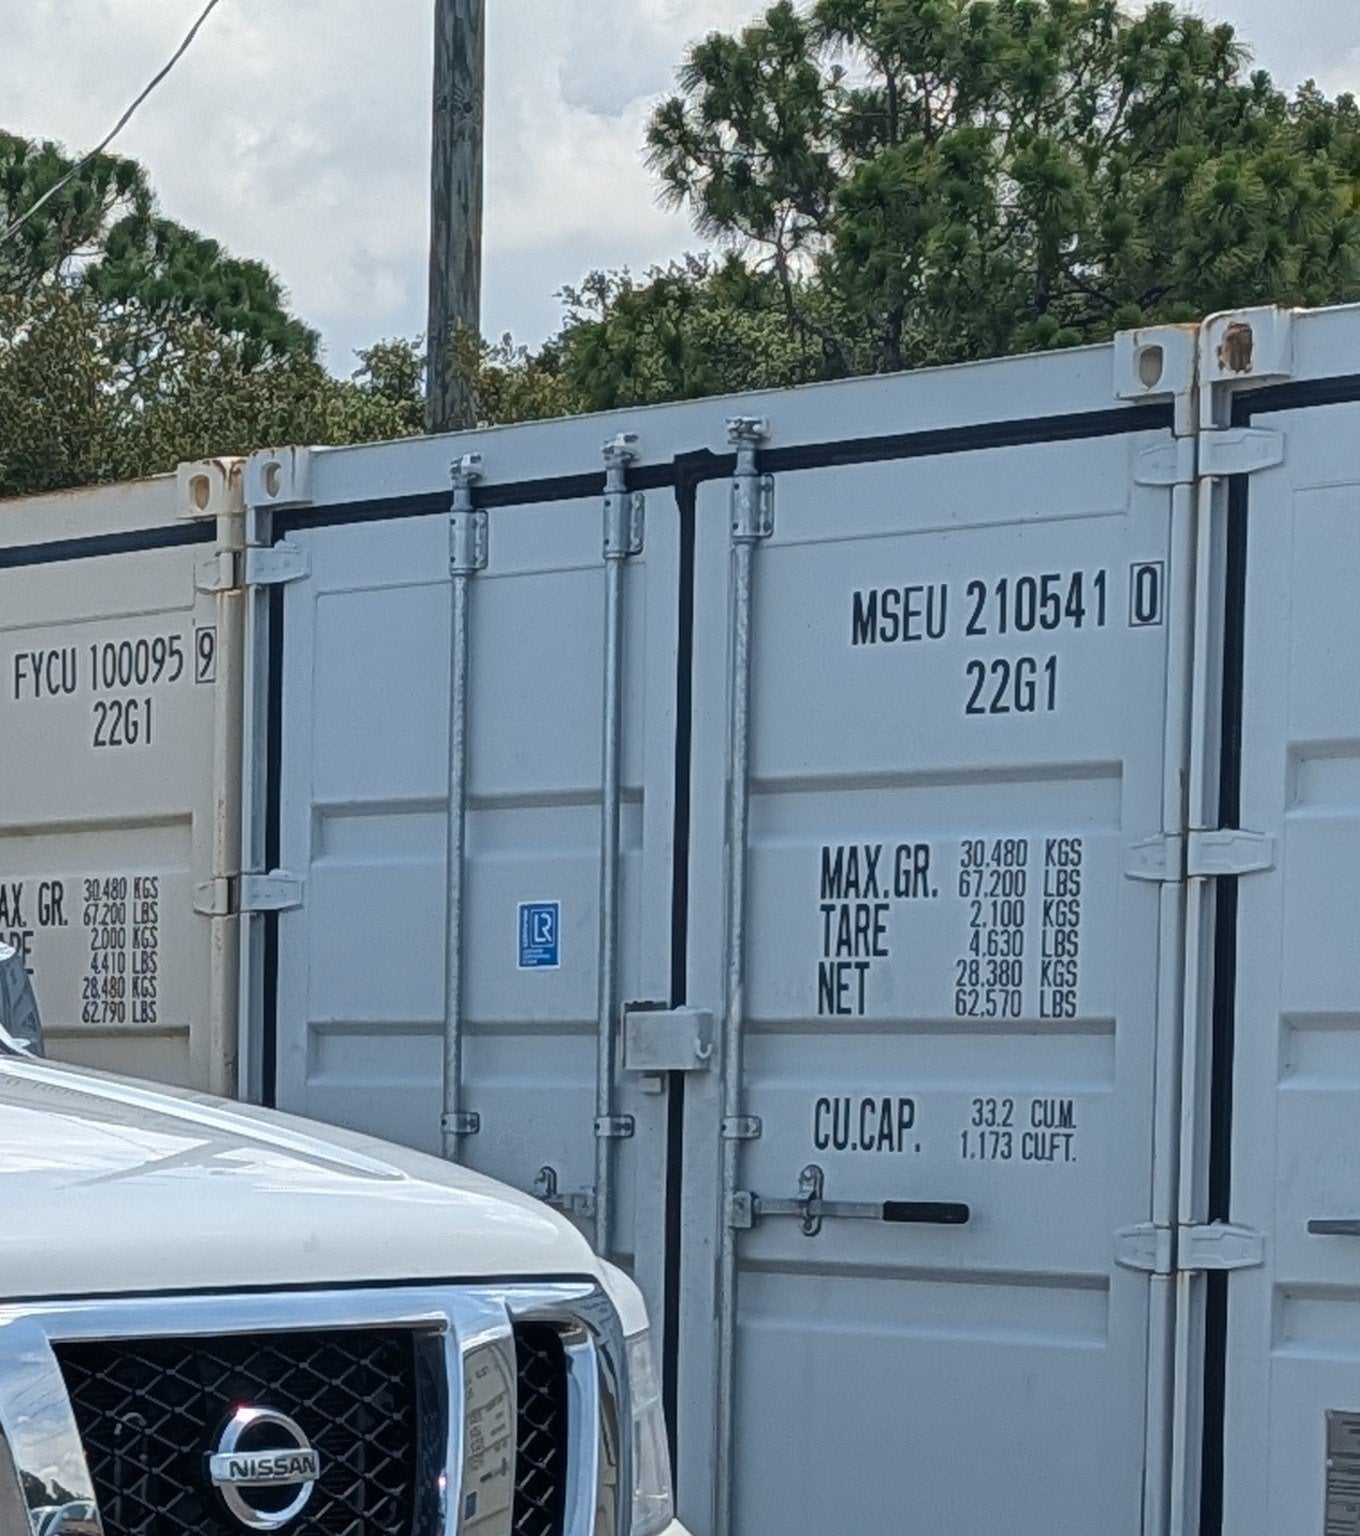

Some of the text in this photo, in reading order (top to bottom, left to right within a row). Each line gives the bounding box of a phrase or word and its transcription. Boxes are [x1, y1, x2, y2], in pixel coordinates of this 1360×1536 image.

[851, 565, 1158, 645] MSEU 210541 0
[14, 631, 214, 699] FYCU 100095 9
[965, 654, 1057, 715] 22G1
[93, 697, 152, 747] 22G1
[960, 838, 1028, 868] 30.480
[1044, 838, 1082, 867] KGS
[959, 869, 1081, 898] 67.200 LBS
[39, 881, 69, 926] GR.
[133, 876, 159, 900] KGS
[83, 901, 158, 926] 67.200 LBS
[132, 926, 158, 949] KGS
[819, 899, 1081, 957] TARE 2.100 KGS
[969, 929, 1079, 958] 4.630 LBS
[132, 951, 158, 974] LBS
[132, 976, 157, 1000] KGS
[818, 959, 1078, 1015] NET 28.380 KGS
[132, 1001, 157, 1023] LBS
[955, 989, 1077, 1018] 62.570 LBS
[814, 1098, 921, 1153] CU.CAP.
[971, 1099, 1014, 1128] 33.2
[961, 1130, 1013, 1160] 1.173
[230, 1456, 315, 1478] NISSAN
